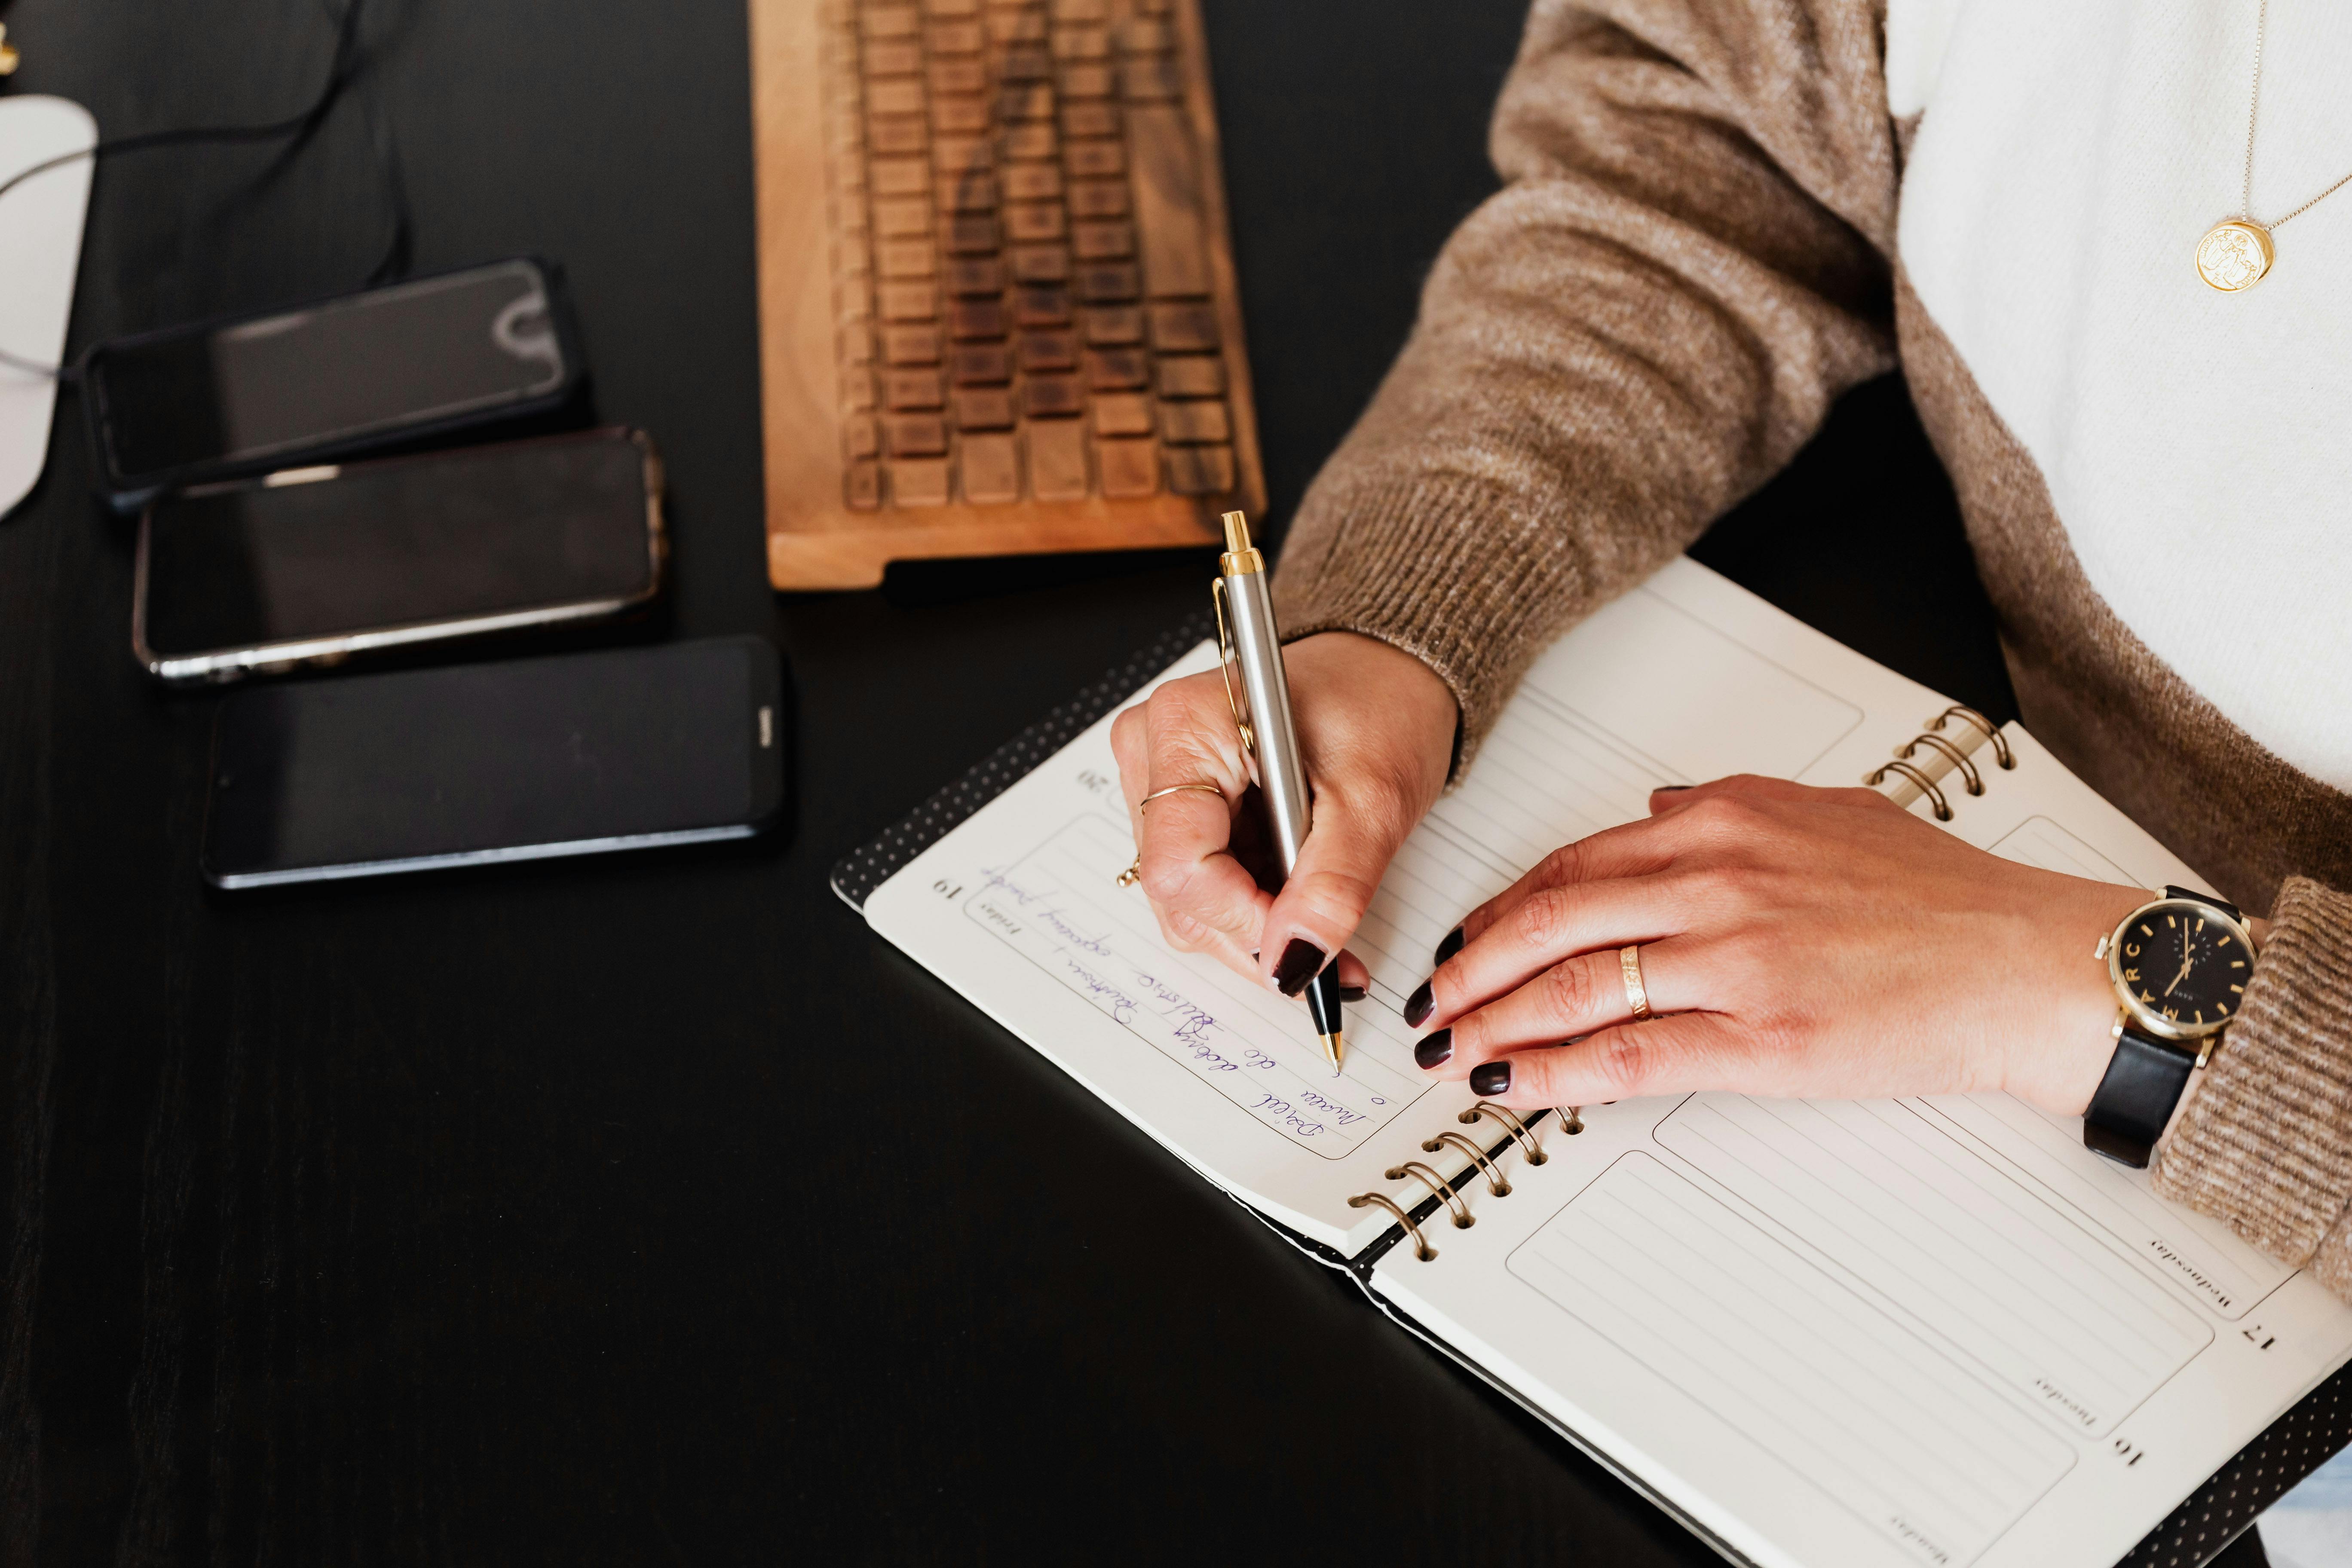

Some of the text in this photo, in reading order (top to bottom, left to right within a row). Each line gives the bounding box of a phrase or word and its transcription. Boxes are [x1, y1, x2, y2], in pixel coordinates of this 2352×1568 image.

[933, 878, 963, 899] 19
[980, 903, 1021, 934] Friday
[1244, 1050, 1276, 1069] do
[2149, 1240, 2231, 1307] Wednesday
[2241, 1324, 2275, 1350] 17
[2035, 1378, 2097, 1426] Tuesday
[2114, 1438, 2144, 1467] 16
[1890, 1516, 1950, 1565] Monday
